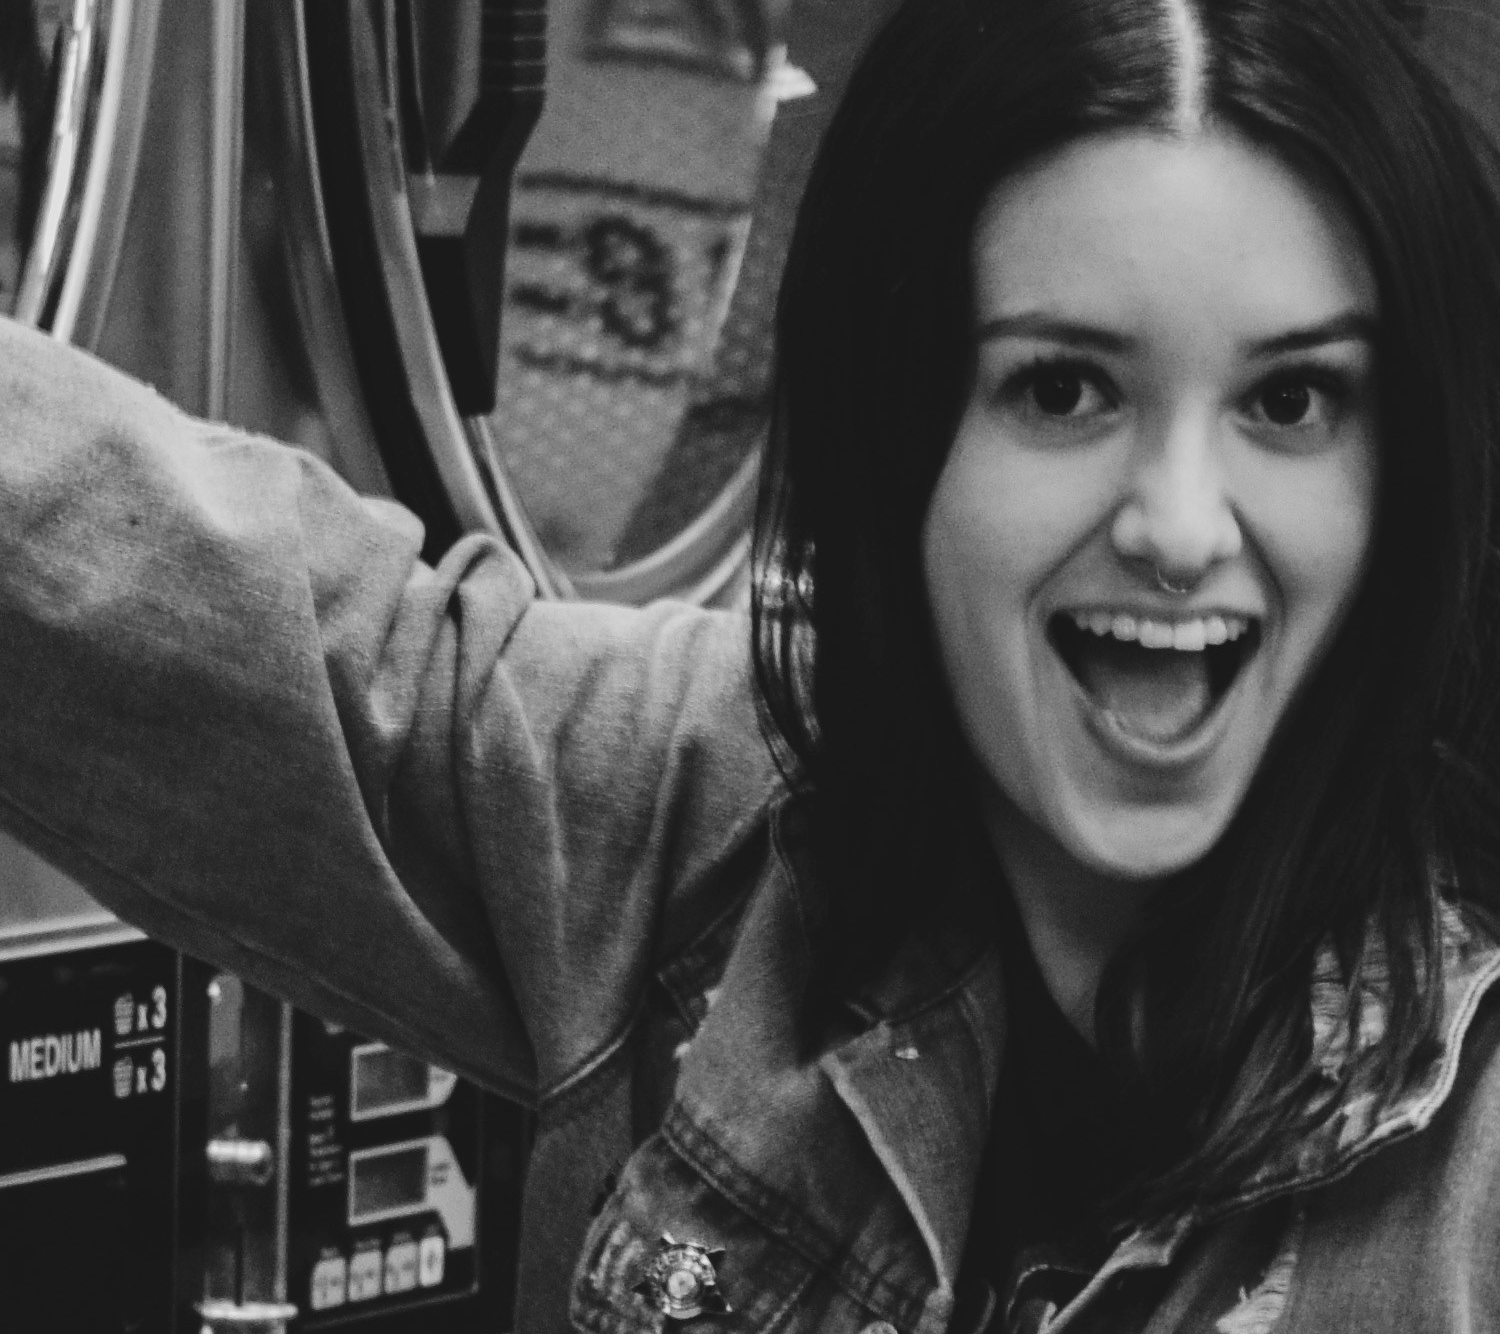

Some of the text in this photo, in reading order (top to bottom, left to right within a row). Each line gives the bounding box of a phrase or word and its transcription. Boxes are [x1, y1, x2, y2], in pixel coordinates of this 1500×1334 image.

[137, 985, 167, 1031] x 3
[9, 1028, 101, 1083] MEDIUM
[136, 1048, 166, 1093] x 3
